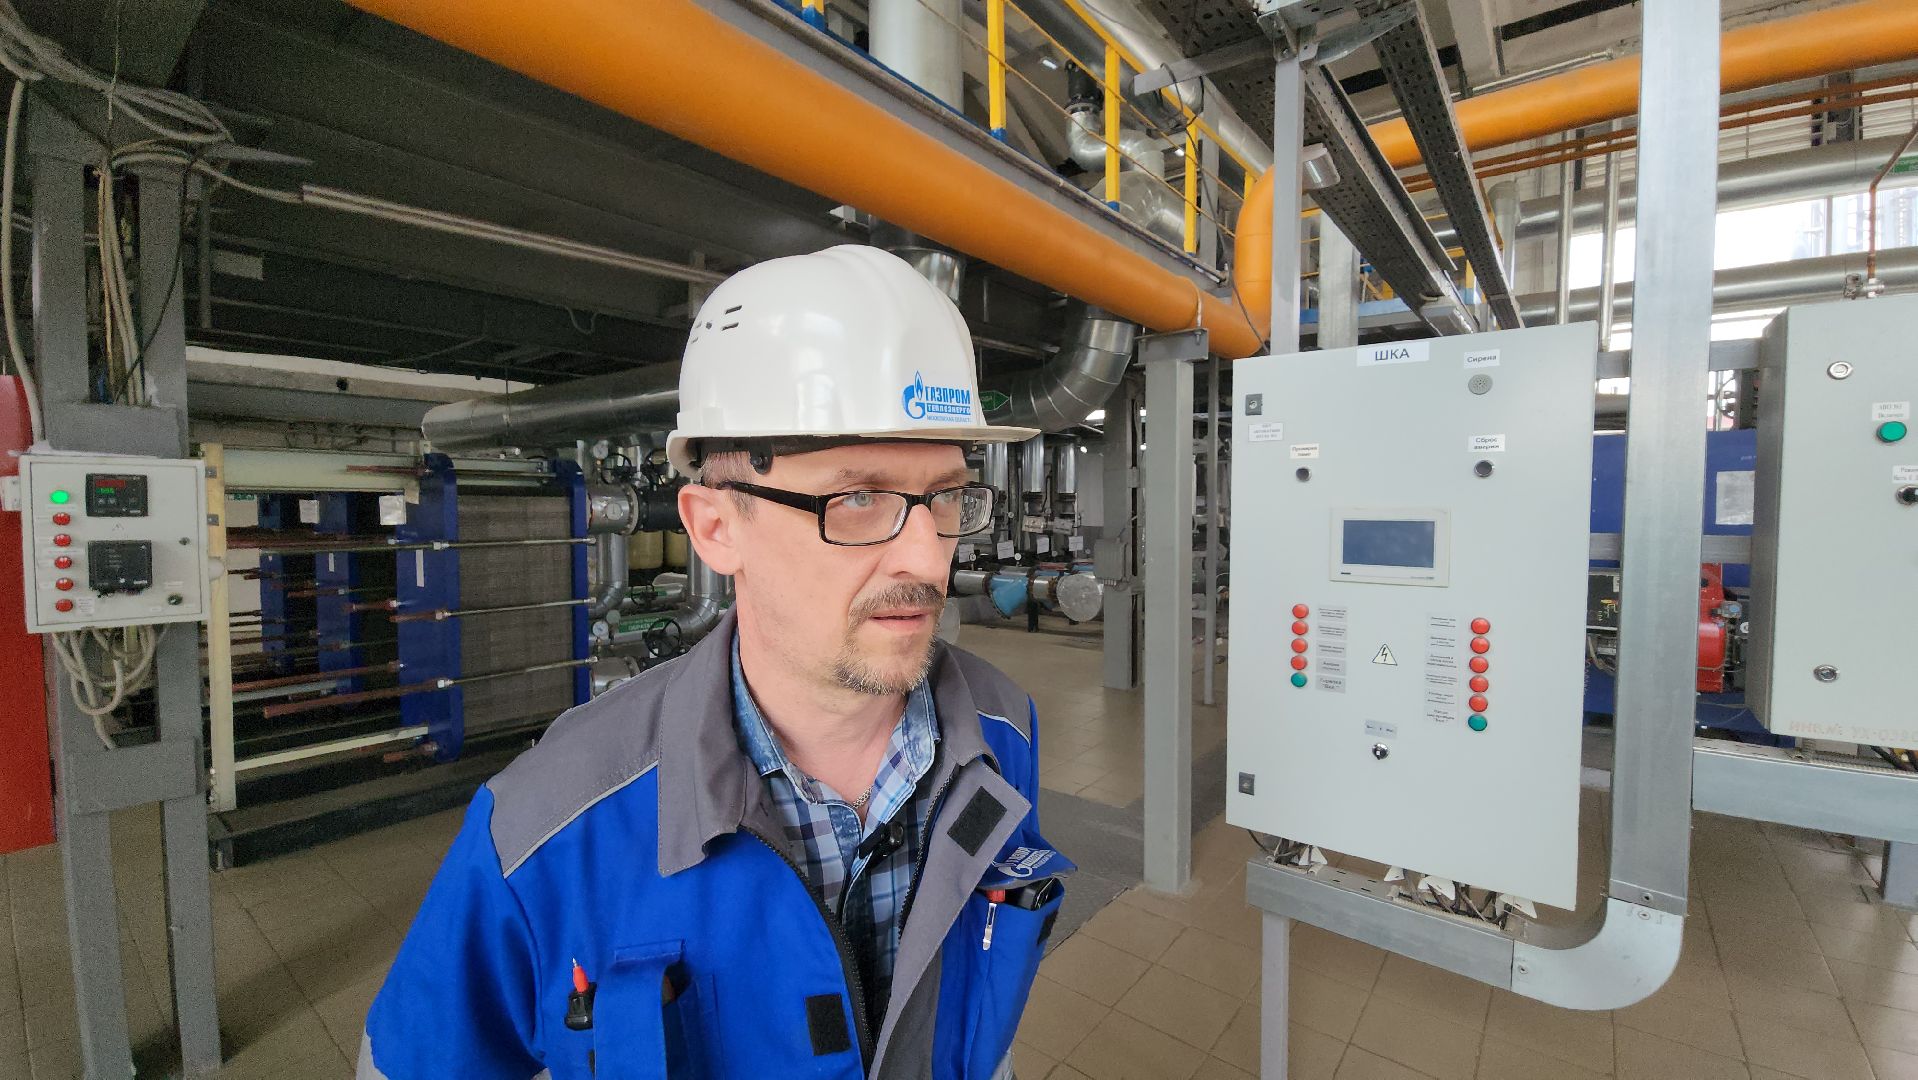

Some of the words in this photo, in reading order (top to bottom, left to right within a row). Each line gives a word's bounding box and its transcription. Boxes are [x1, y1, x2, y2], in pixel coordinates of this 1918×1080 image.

[1374, 348, 1410, 361] ШКА
[1466, 354, 1497, 364] Сирена
[925, 386, 971, 405] ГАЗПРОМ
